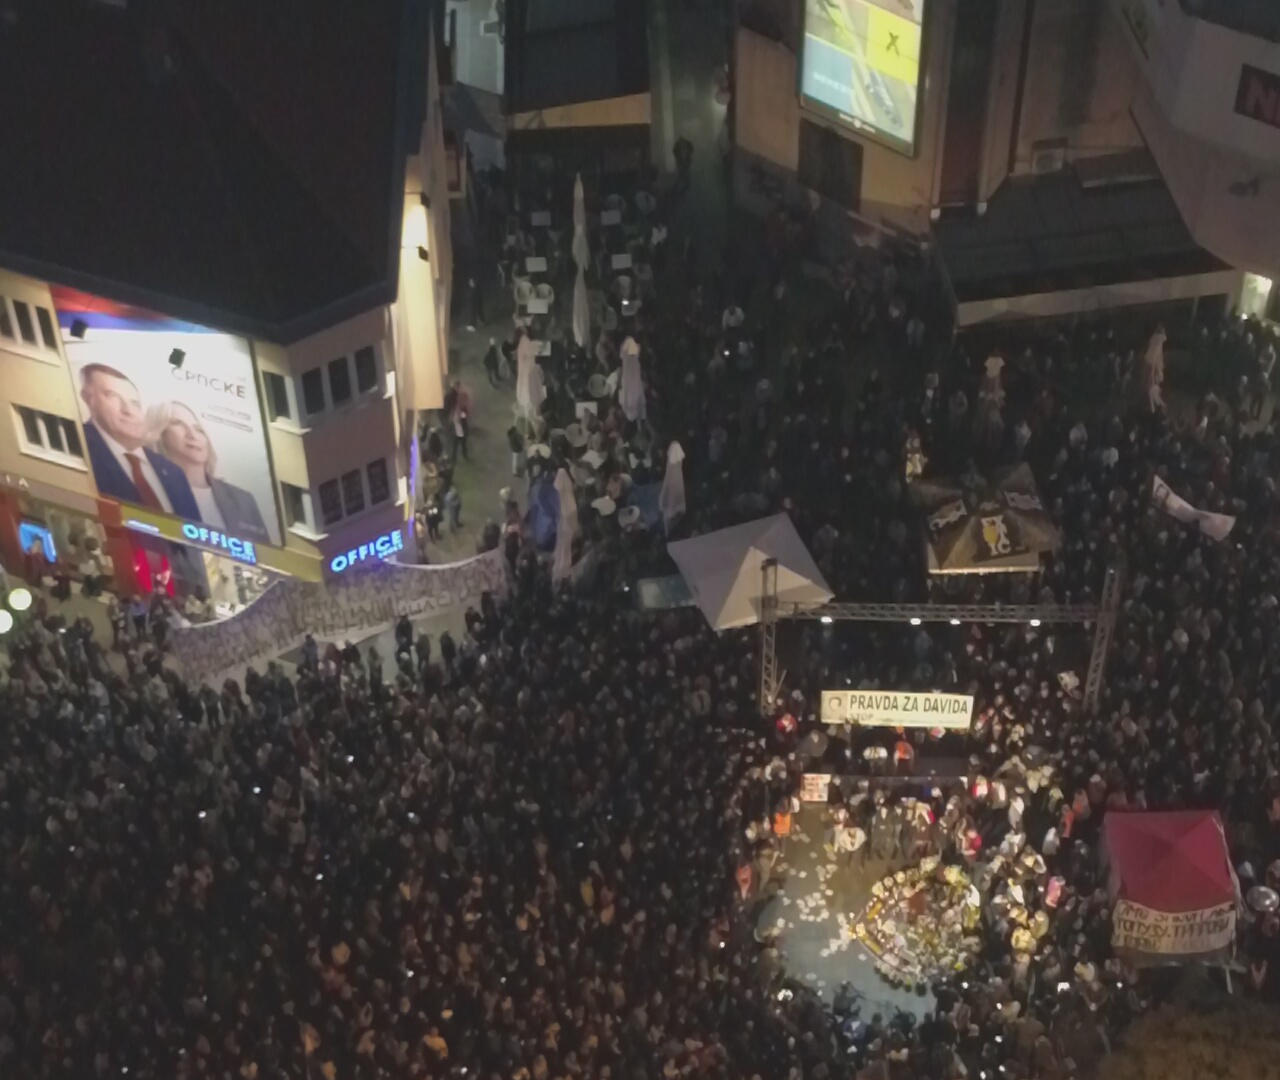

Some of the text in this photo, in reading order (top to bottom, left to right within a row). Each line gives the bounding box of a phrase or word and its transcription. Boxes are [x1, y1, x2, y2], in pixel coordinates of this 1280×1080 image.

[171, 366, 247, 400] СРПСКЕ
[182, 523, 255, 555] OFFICE
[330, 529, 402, 574] OFFICE
[849, 694, 969, 714] PRAVDA ZA DAVIDA
